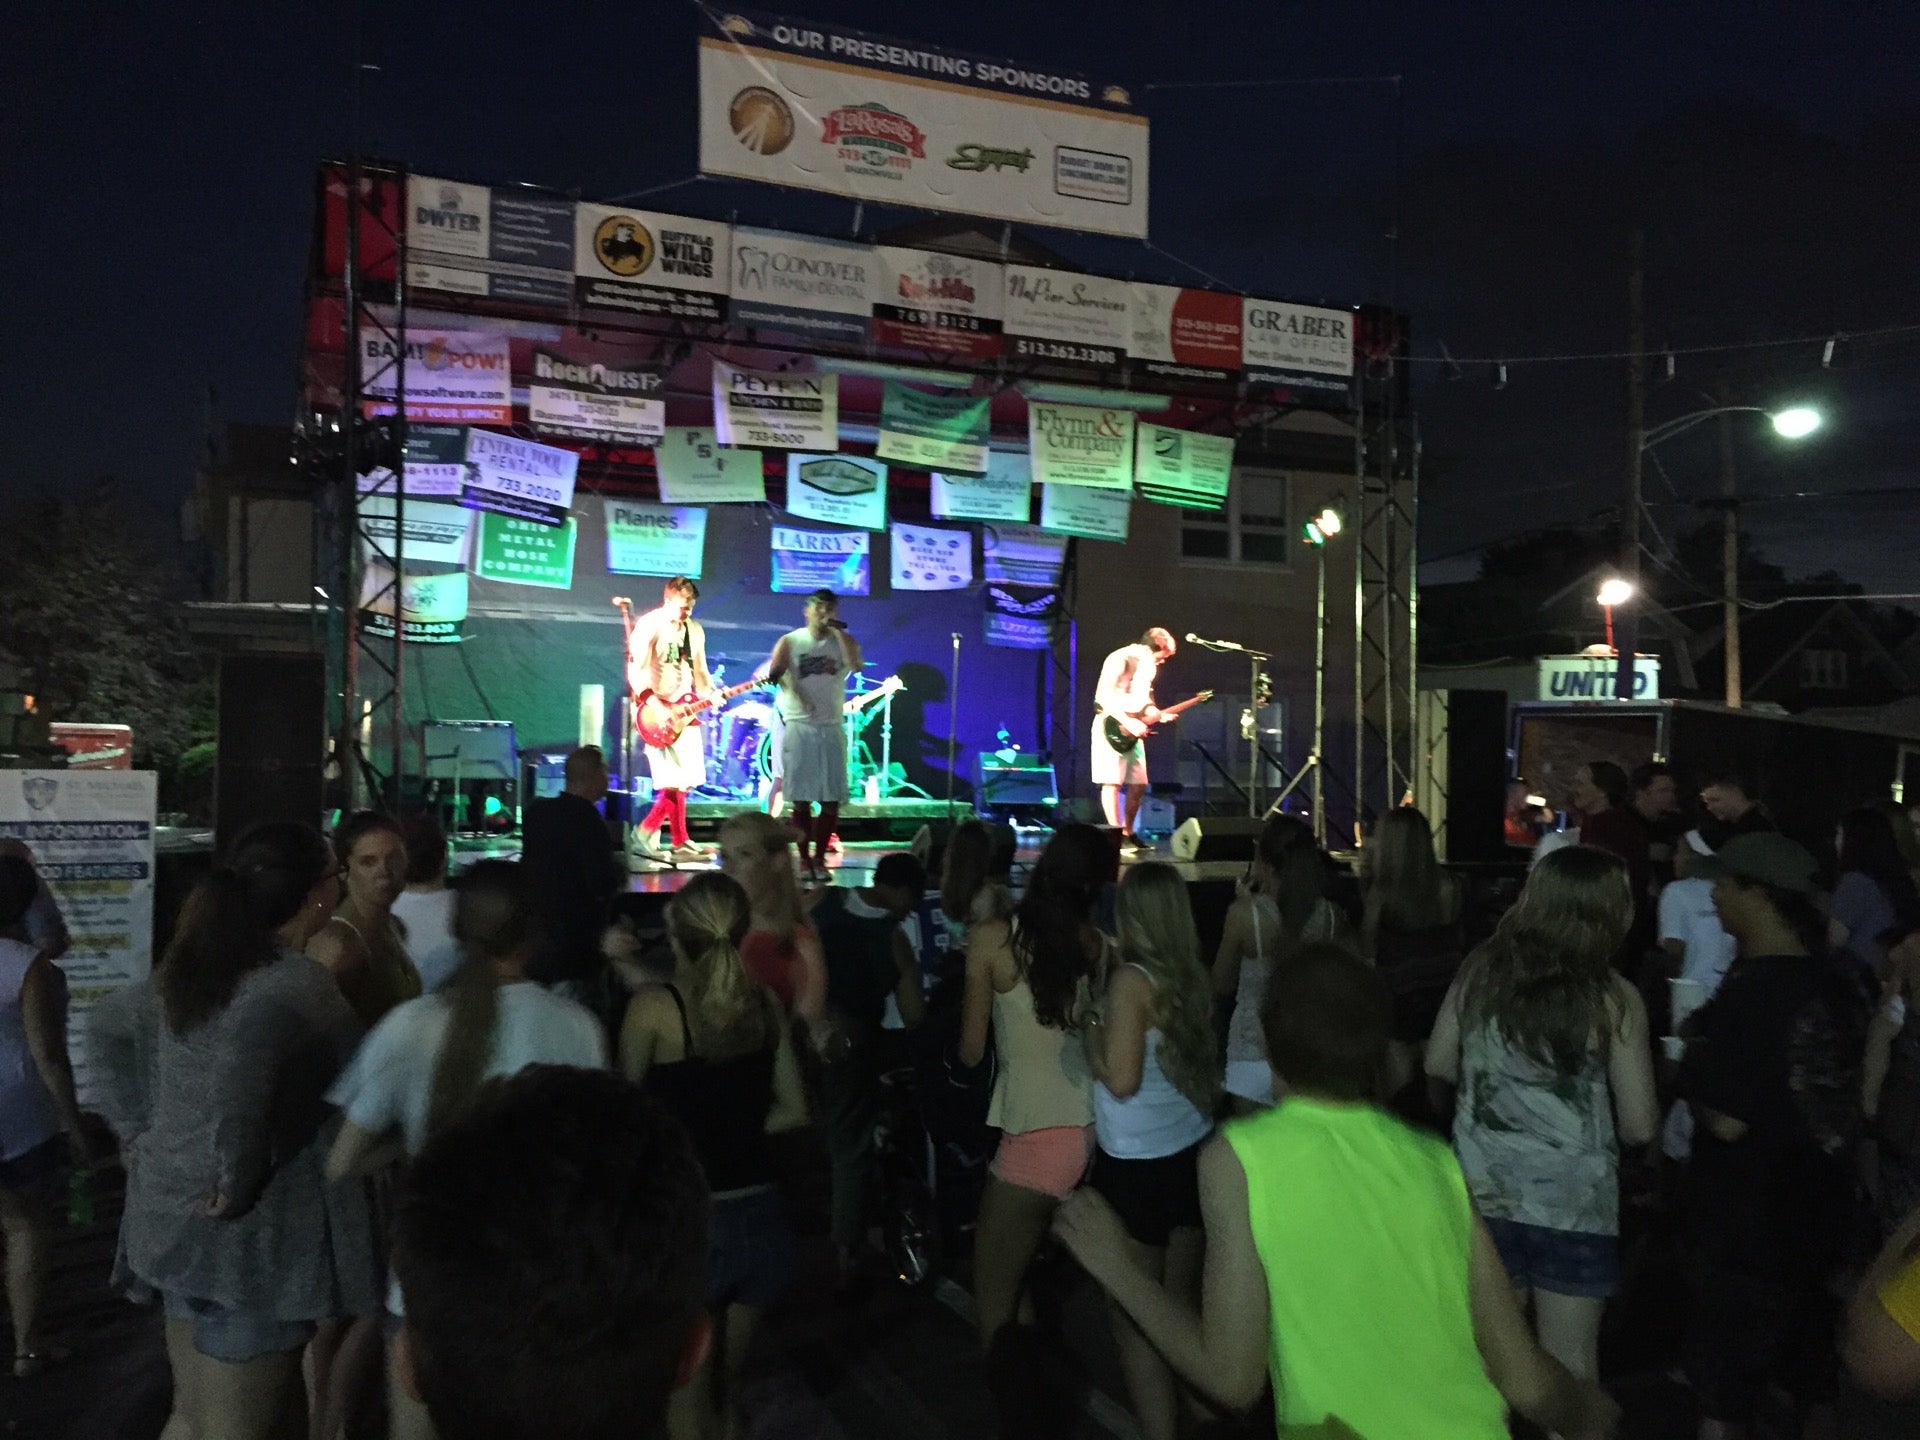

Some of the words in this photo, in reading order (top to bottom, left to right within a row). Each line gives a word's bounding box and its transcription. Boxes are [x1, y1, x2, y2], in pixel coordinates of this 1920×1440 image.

[773, 26, 825, 51] OUR
[829, 35, 971, 77] PRESENTING
[975, 63, 1090, 99] SPONSORS
[417, 206, 481, 233] DWYER
[661, 241, 714, 264] WILD
[660, 258, 714, 279] WINGS
[772, 252, 866, 283] CONOVER
[1249, 308, 1347, 340] GRABER
[1249, 332, 1282, 346] LAW
[1289, 333, 1349, 354] OFFICE
[449, 351, 505, 371] POW!
[1036, 408, 1095, 434] Flynn
[1095, 410, 1126, 438] &
[1046, 430, 1124, 458] Company
[497, 476, 562, 502] 733.2020
[505, 520, 550, 533] OHIO
[614, 508, 680, 530] Planes
[498, 533, 557, 549] METAL
[779, 532, 863, 552] LARRY'S
[503, 548, 549, 563] HOSE
[483, 560, 566, 578] COMPANY
[1551, 671, 1648, 697] UNITD
